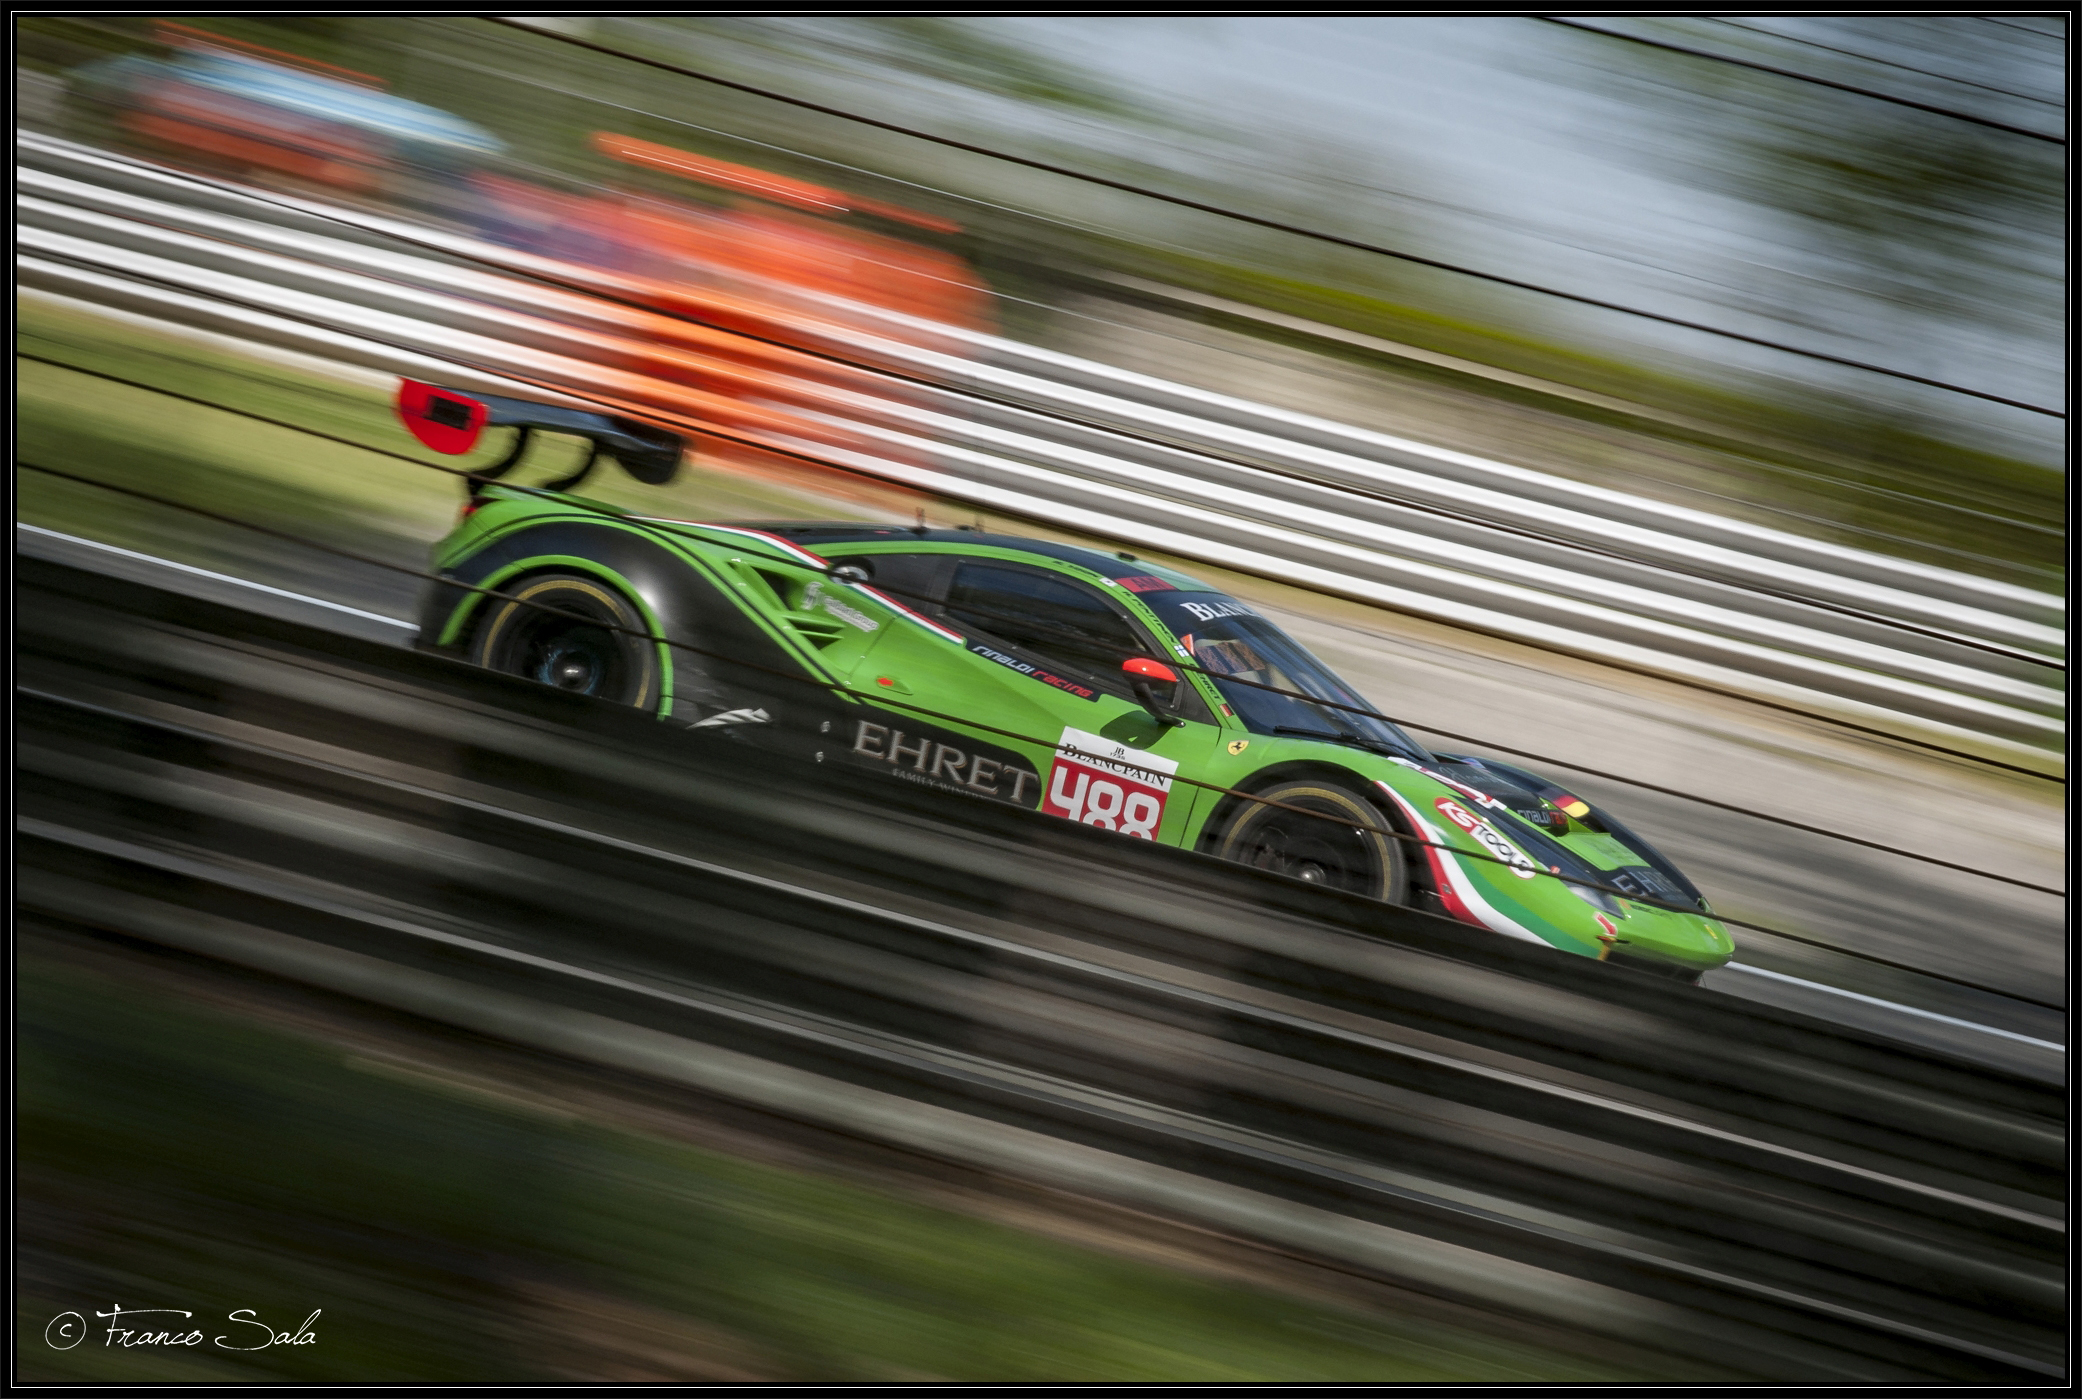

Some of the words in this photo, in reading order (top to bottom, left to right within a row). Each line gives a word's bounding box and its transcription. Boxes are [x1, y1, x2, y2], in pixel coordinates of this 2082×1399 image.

[1032, 670, 1095, 698] racing
[852, 720, 1040, 803] EHRET
[1062, 742, 1166, 787] BLANCPAIN
[1050, 765, 1160, 841] 488
[1437, 801, 1481, 828] KS
